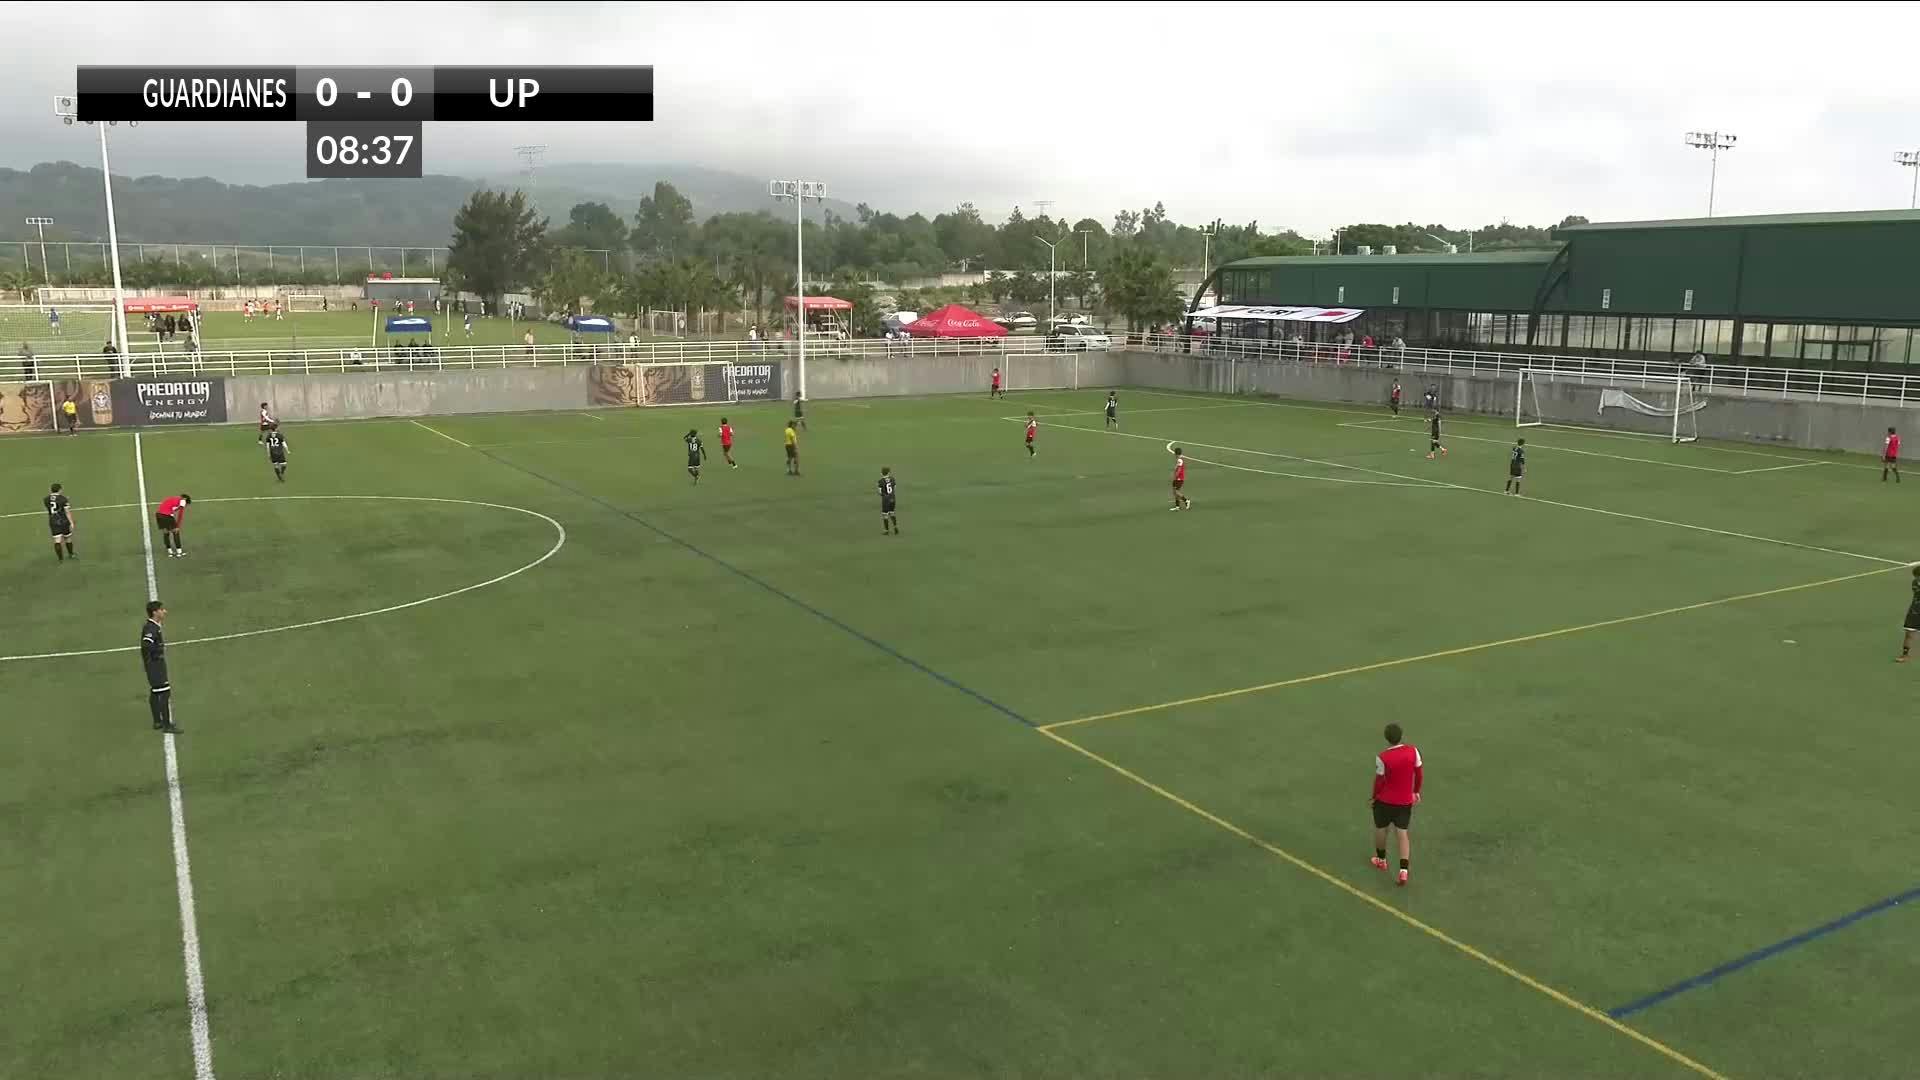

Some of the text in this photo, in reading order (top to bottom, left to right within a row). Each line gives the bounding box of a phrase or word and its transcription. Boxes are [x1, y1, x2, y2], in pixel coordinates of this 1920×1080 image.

[137, 381, 210, 405] PREDATOR
[145, 398, 205, 406] ENERGY
[270, 437, 279, 447] 12
[689, 442, 698, 452] 18
[886, 482, 893, 494] 6
[50, 501, 58, 514] 2
